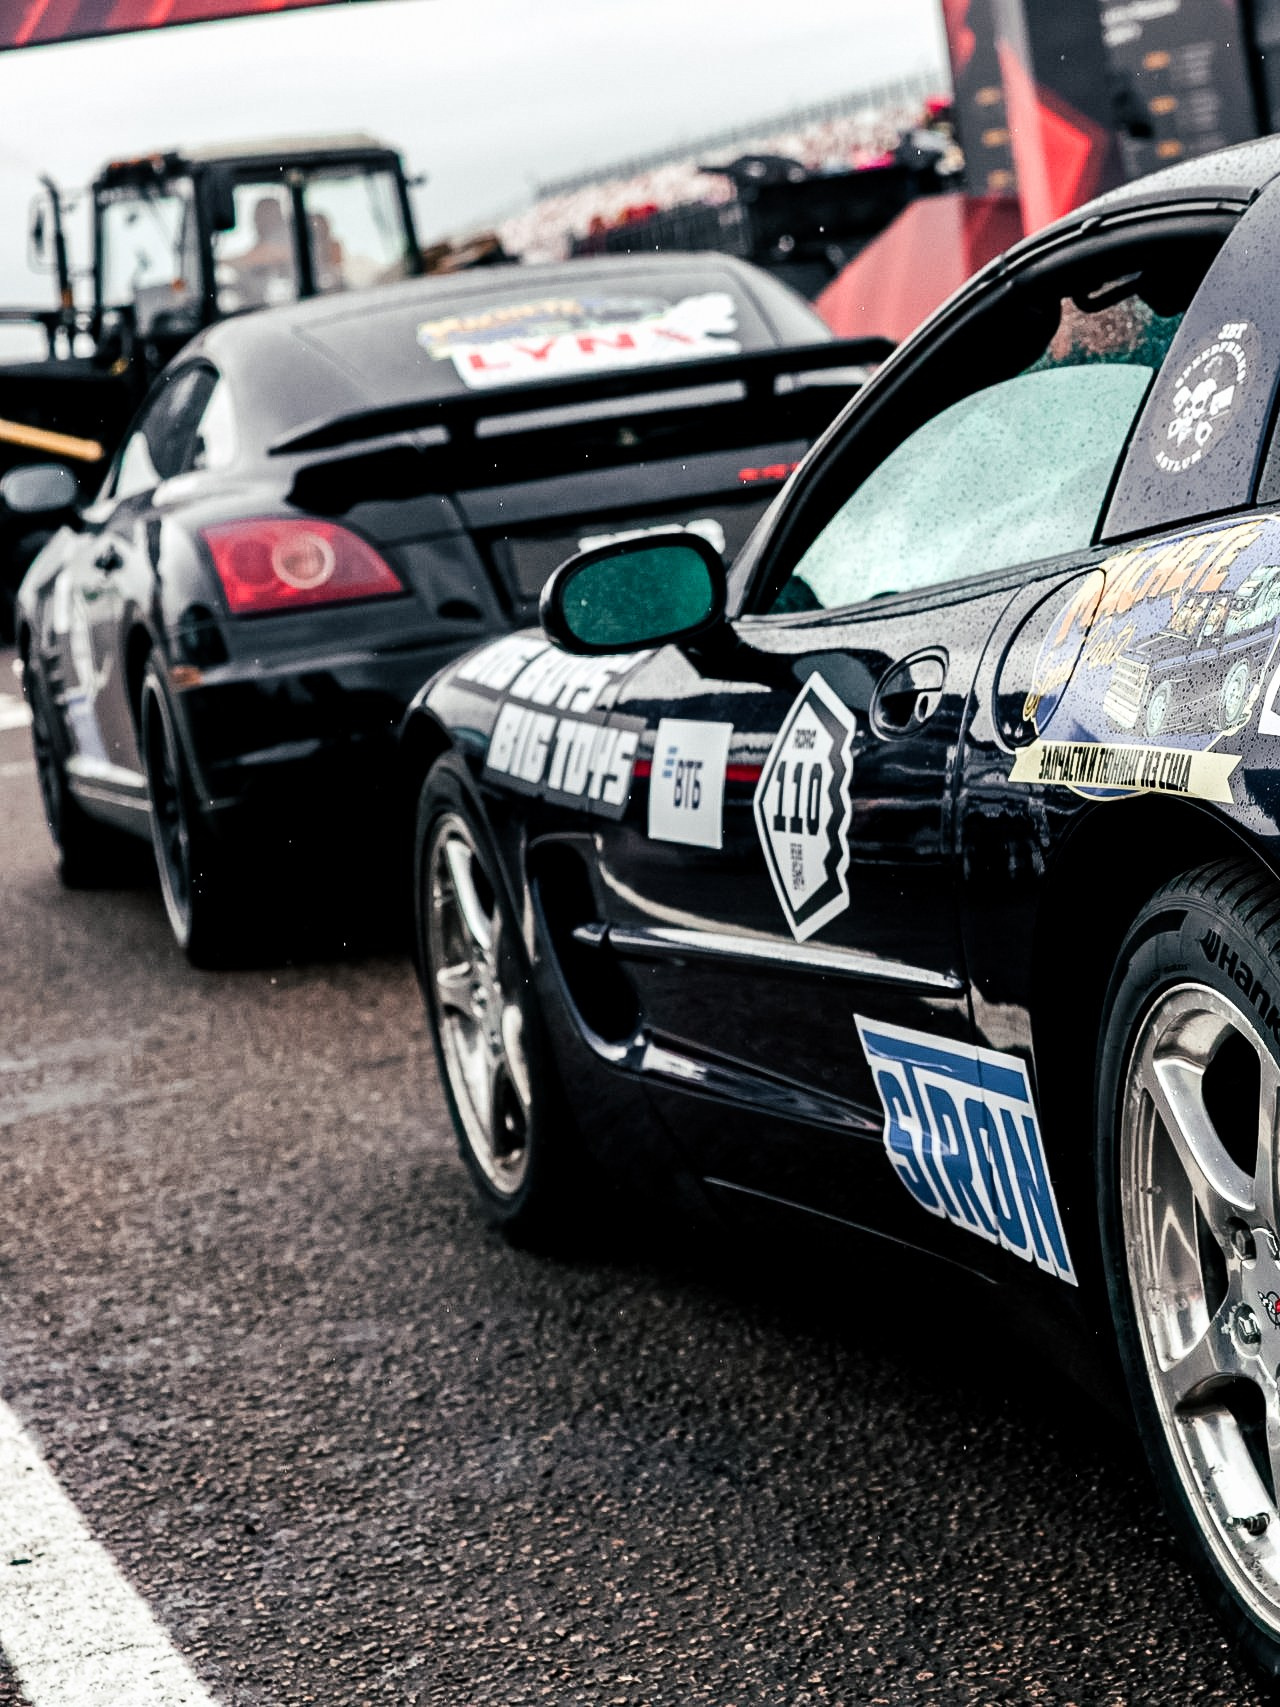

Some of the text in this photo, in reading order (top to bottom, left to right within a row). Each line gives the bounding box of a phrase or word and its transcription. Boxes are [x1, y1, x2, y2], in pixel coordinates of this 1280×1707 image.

[1050, 518, 1268, 648] MACHETE
[485, 701, 641, 807] BIG TOYS
[772, 760, 824, 837] 110
[1140, 750, 1162, 789] ИЗ
